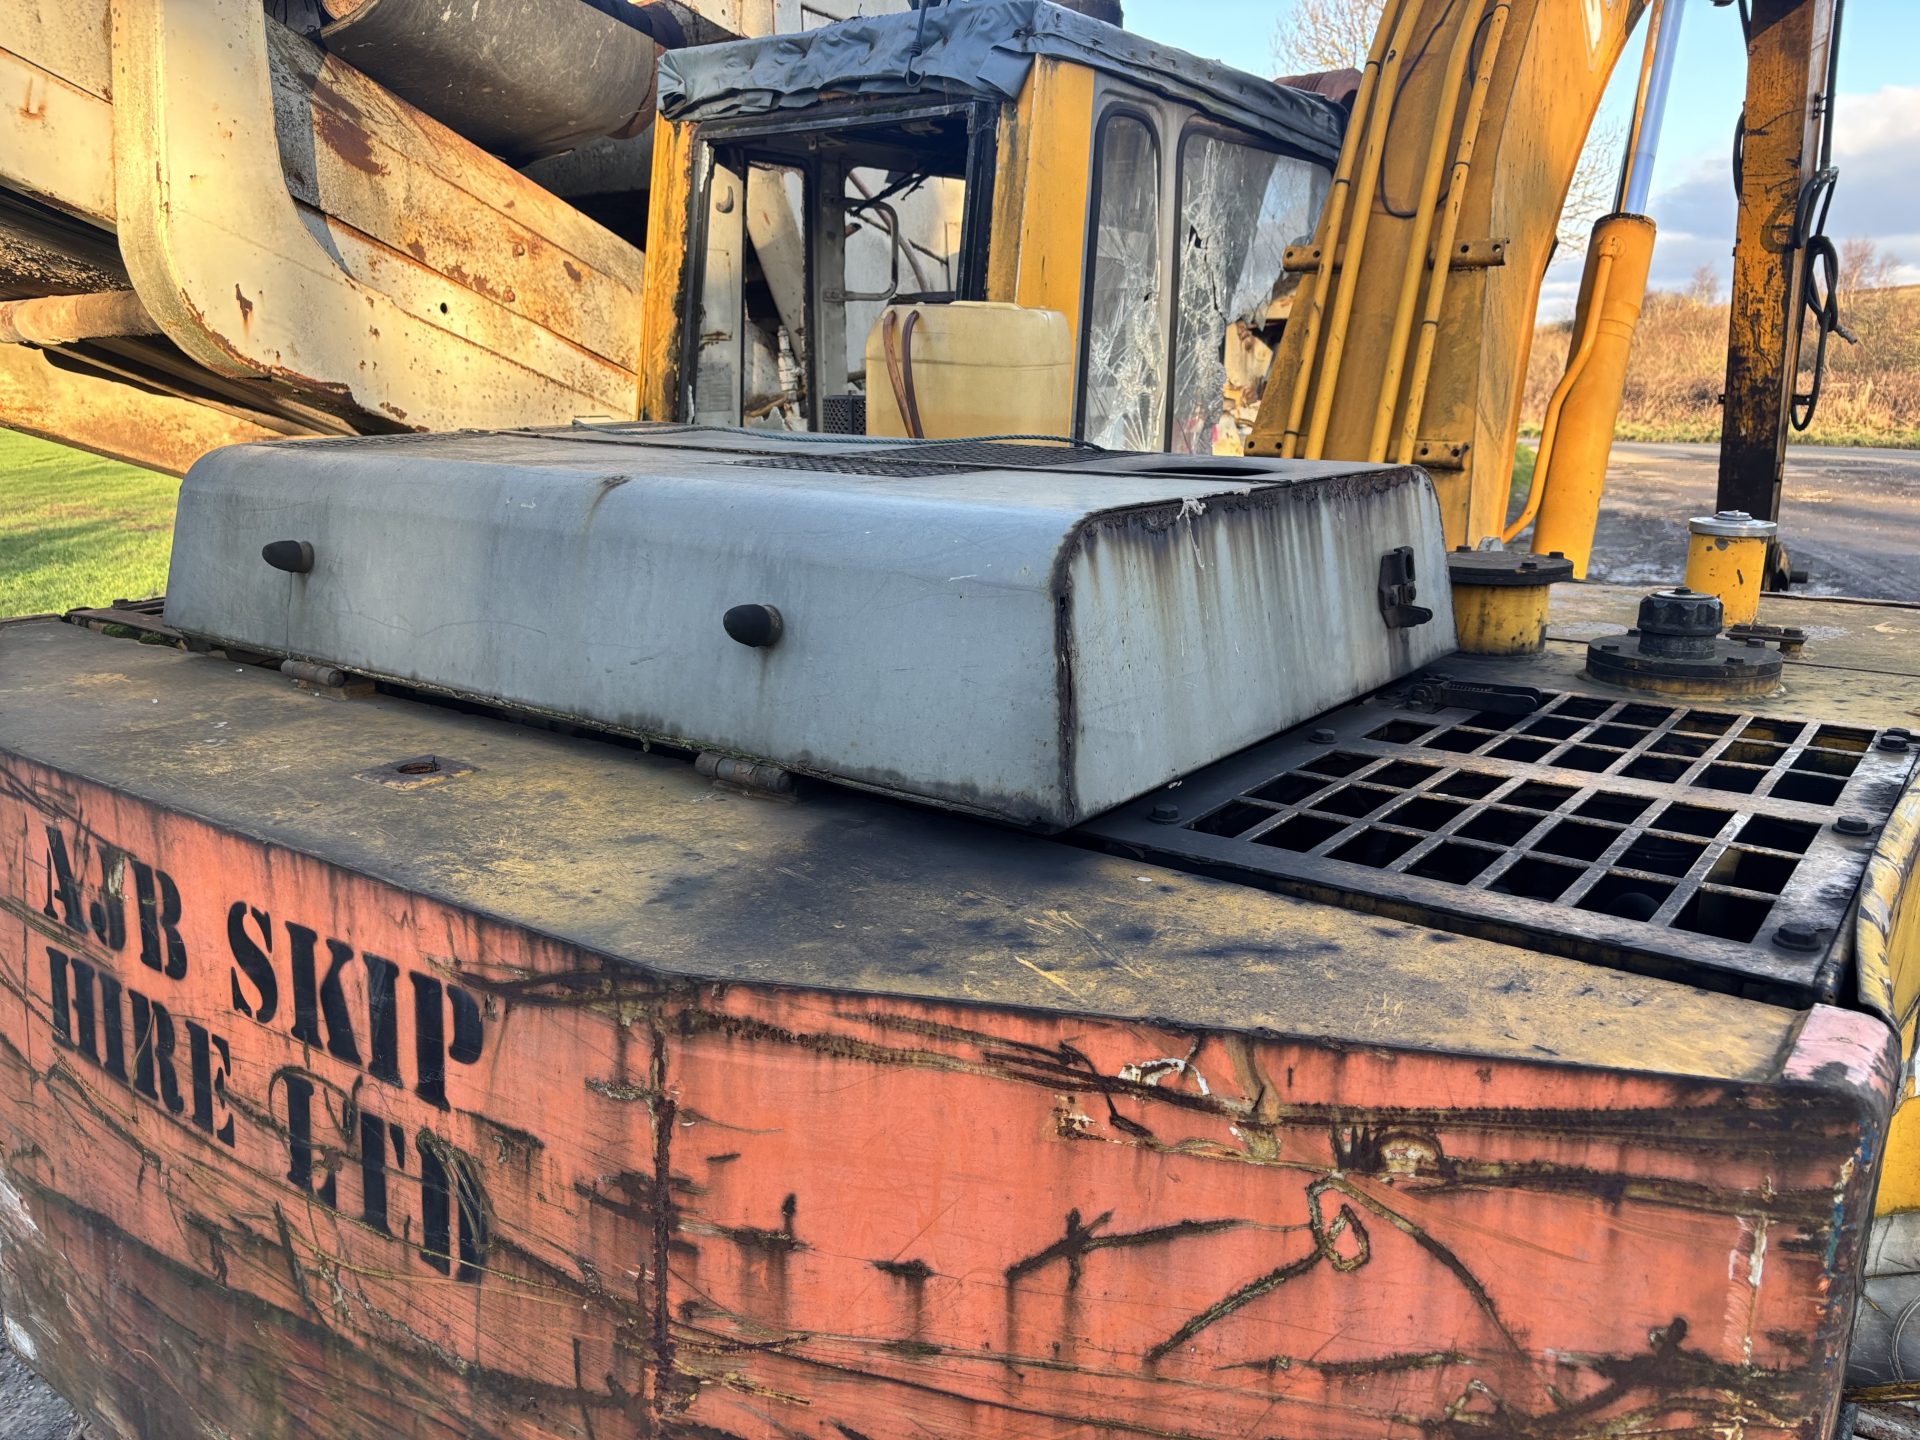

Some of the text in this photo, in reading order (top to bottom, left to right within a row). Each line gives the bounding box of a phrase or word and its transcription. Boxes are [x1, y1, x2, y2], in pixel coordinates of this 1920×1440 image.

[44, 826, 485, 1112] AJB SKIP
[46, 946, 488, 1283] HIRE LTD
